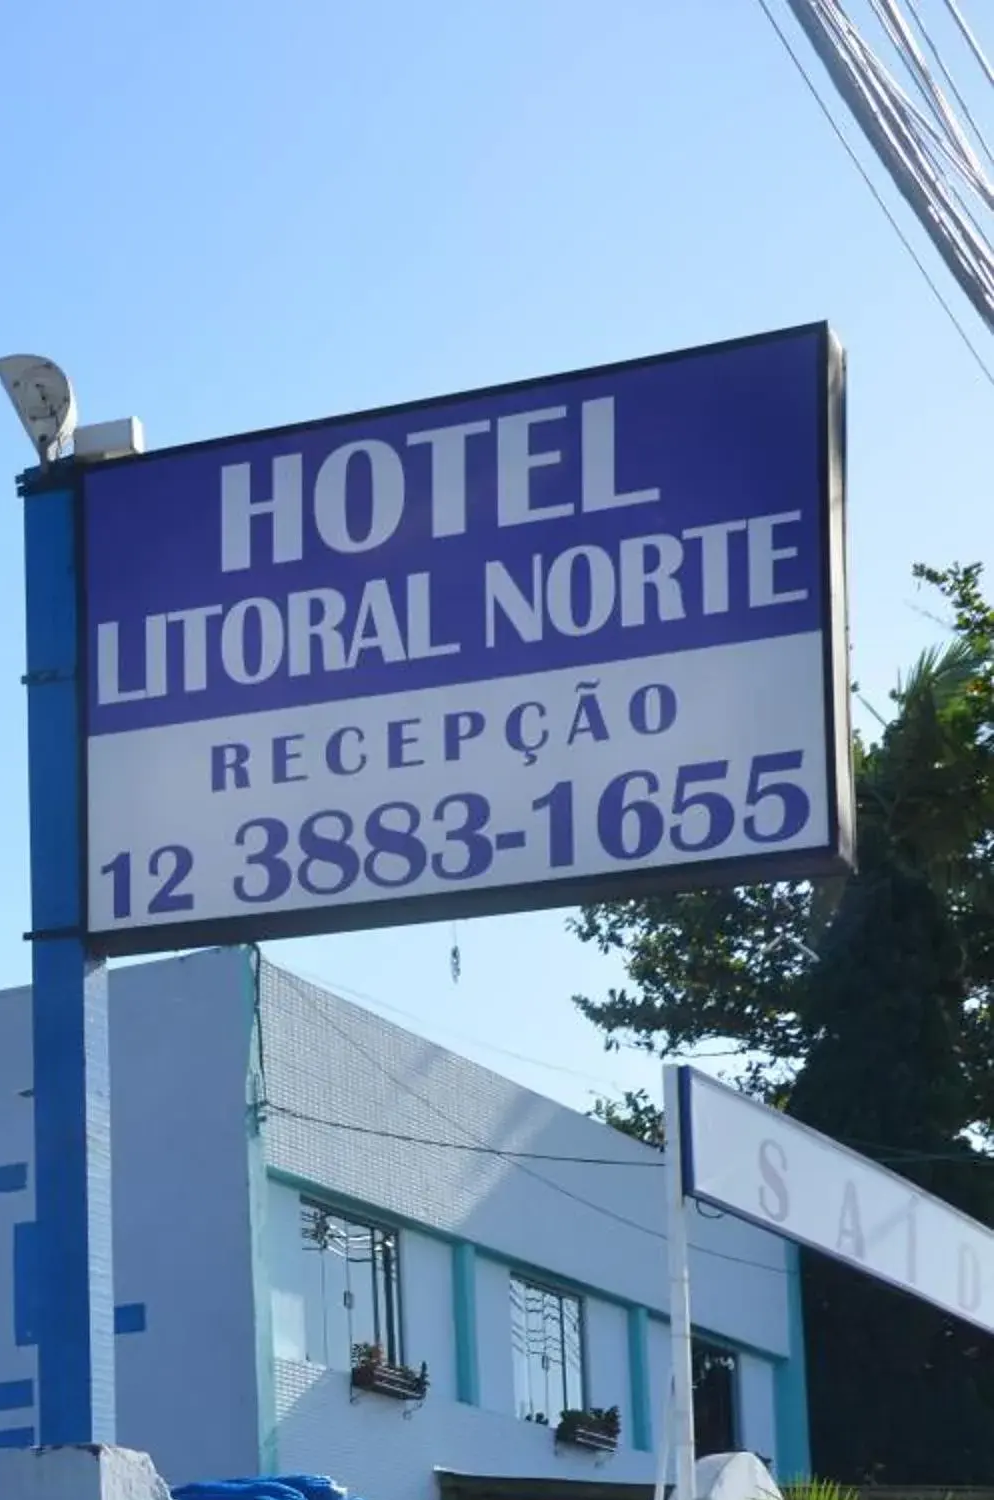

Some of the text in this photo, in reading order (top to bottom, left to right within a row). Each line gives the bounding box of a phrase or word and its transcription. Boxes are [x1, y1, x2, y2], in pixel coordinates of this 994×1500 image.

[221, 397, 660, 573] HOTEL
[97, 510, 809, 706] LITORAL NORTE
[211, 680, 678, 792] RECEPÇÃO
[100, 750, 811, 919] 12 3883-1655
